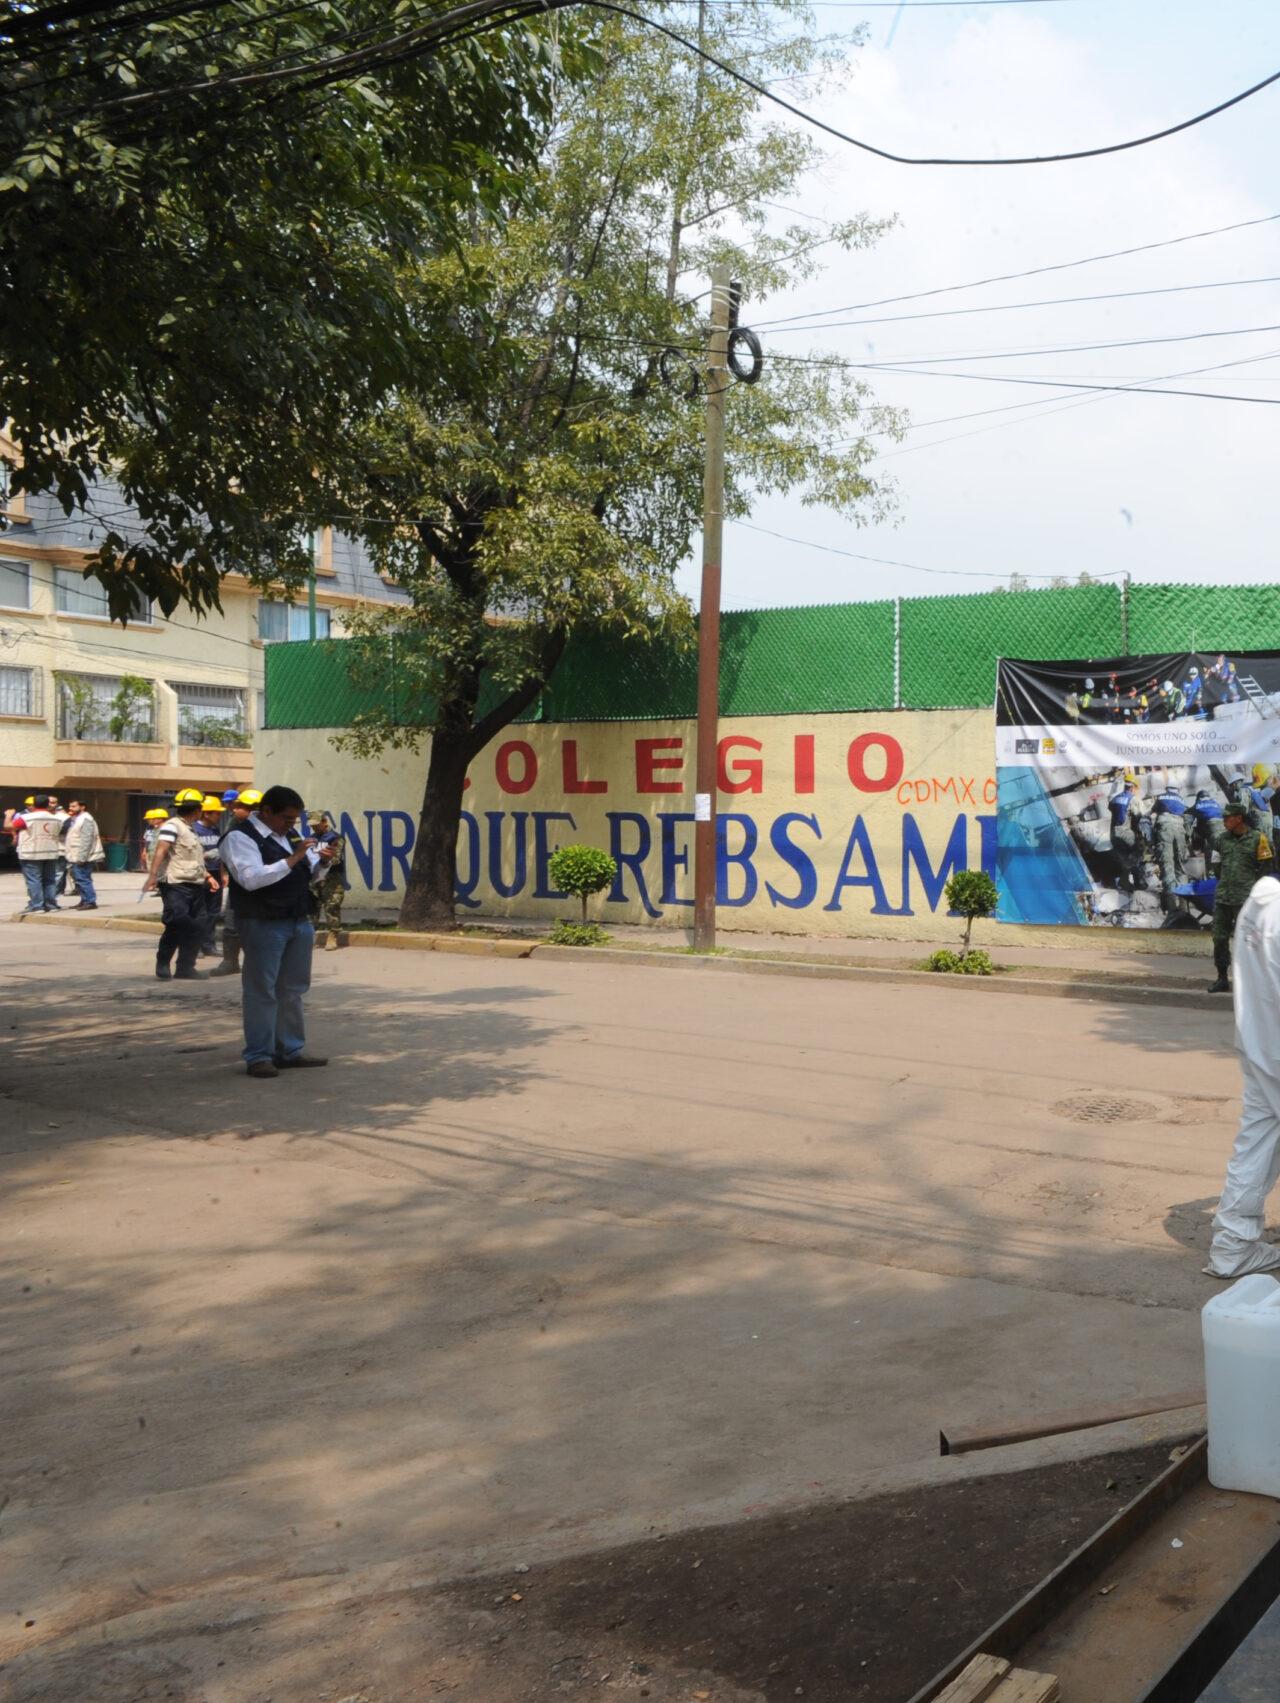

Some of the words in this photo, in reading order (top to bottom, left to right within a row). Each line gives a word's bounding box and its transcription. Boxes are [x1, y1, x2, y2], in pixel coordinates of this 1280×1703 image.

[463, 732, 904, 795] OLEGIO
[898, 776, 976, 805] CDMX
[302, 810, 577, 908] NRQUE
